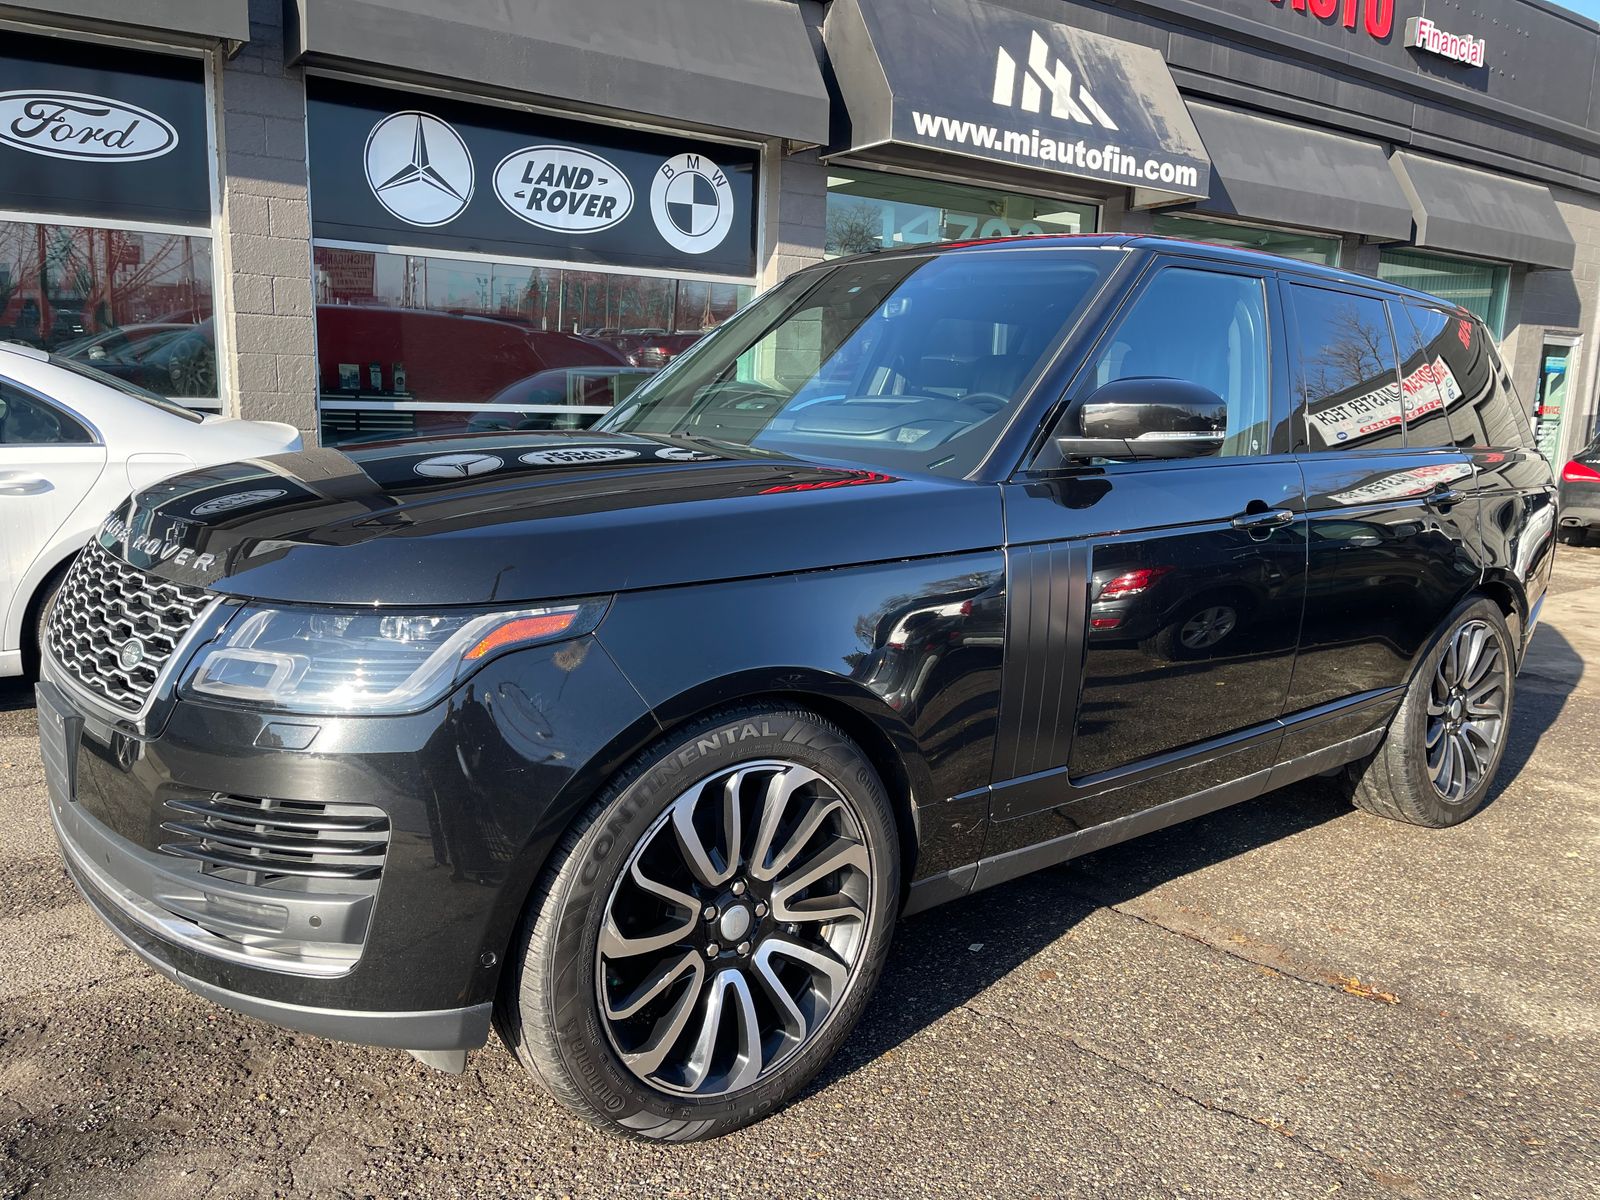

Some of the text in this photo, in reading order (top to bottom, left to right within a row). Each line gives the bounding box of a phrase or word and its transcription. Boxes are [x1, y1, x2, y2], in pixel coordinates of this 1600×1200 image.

[1418, 19, 1484, 66] Financial
[11, 100, 140, 149] Ford
[912, 111, 1197, 187] www.miautofin.com
[521, 160, 594, 190] LAND
[661, 155, 728, 188] BMW
[526, 187, 617, 219] ROVER
[132, 535, 216, 571] ROVER
[580, 721, 778, 887] CONTINENTAL
